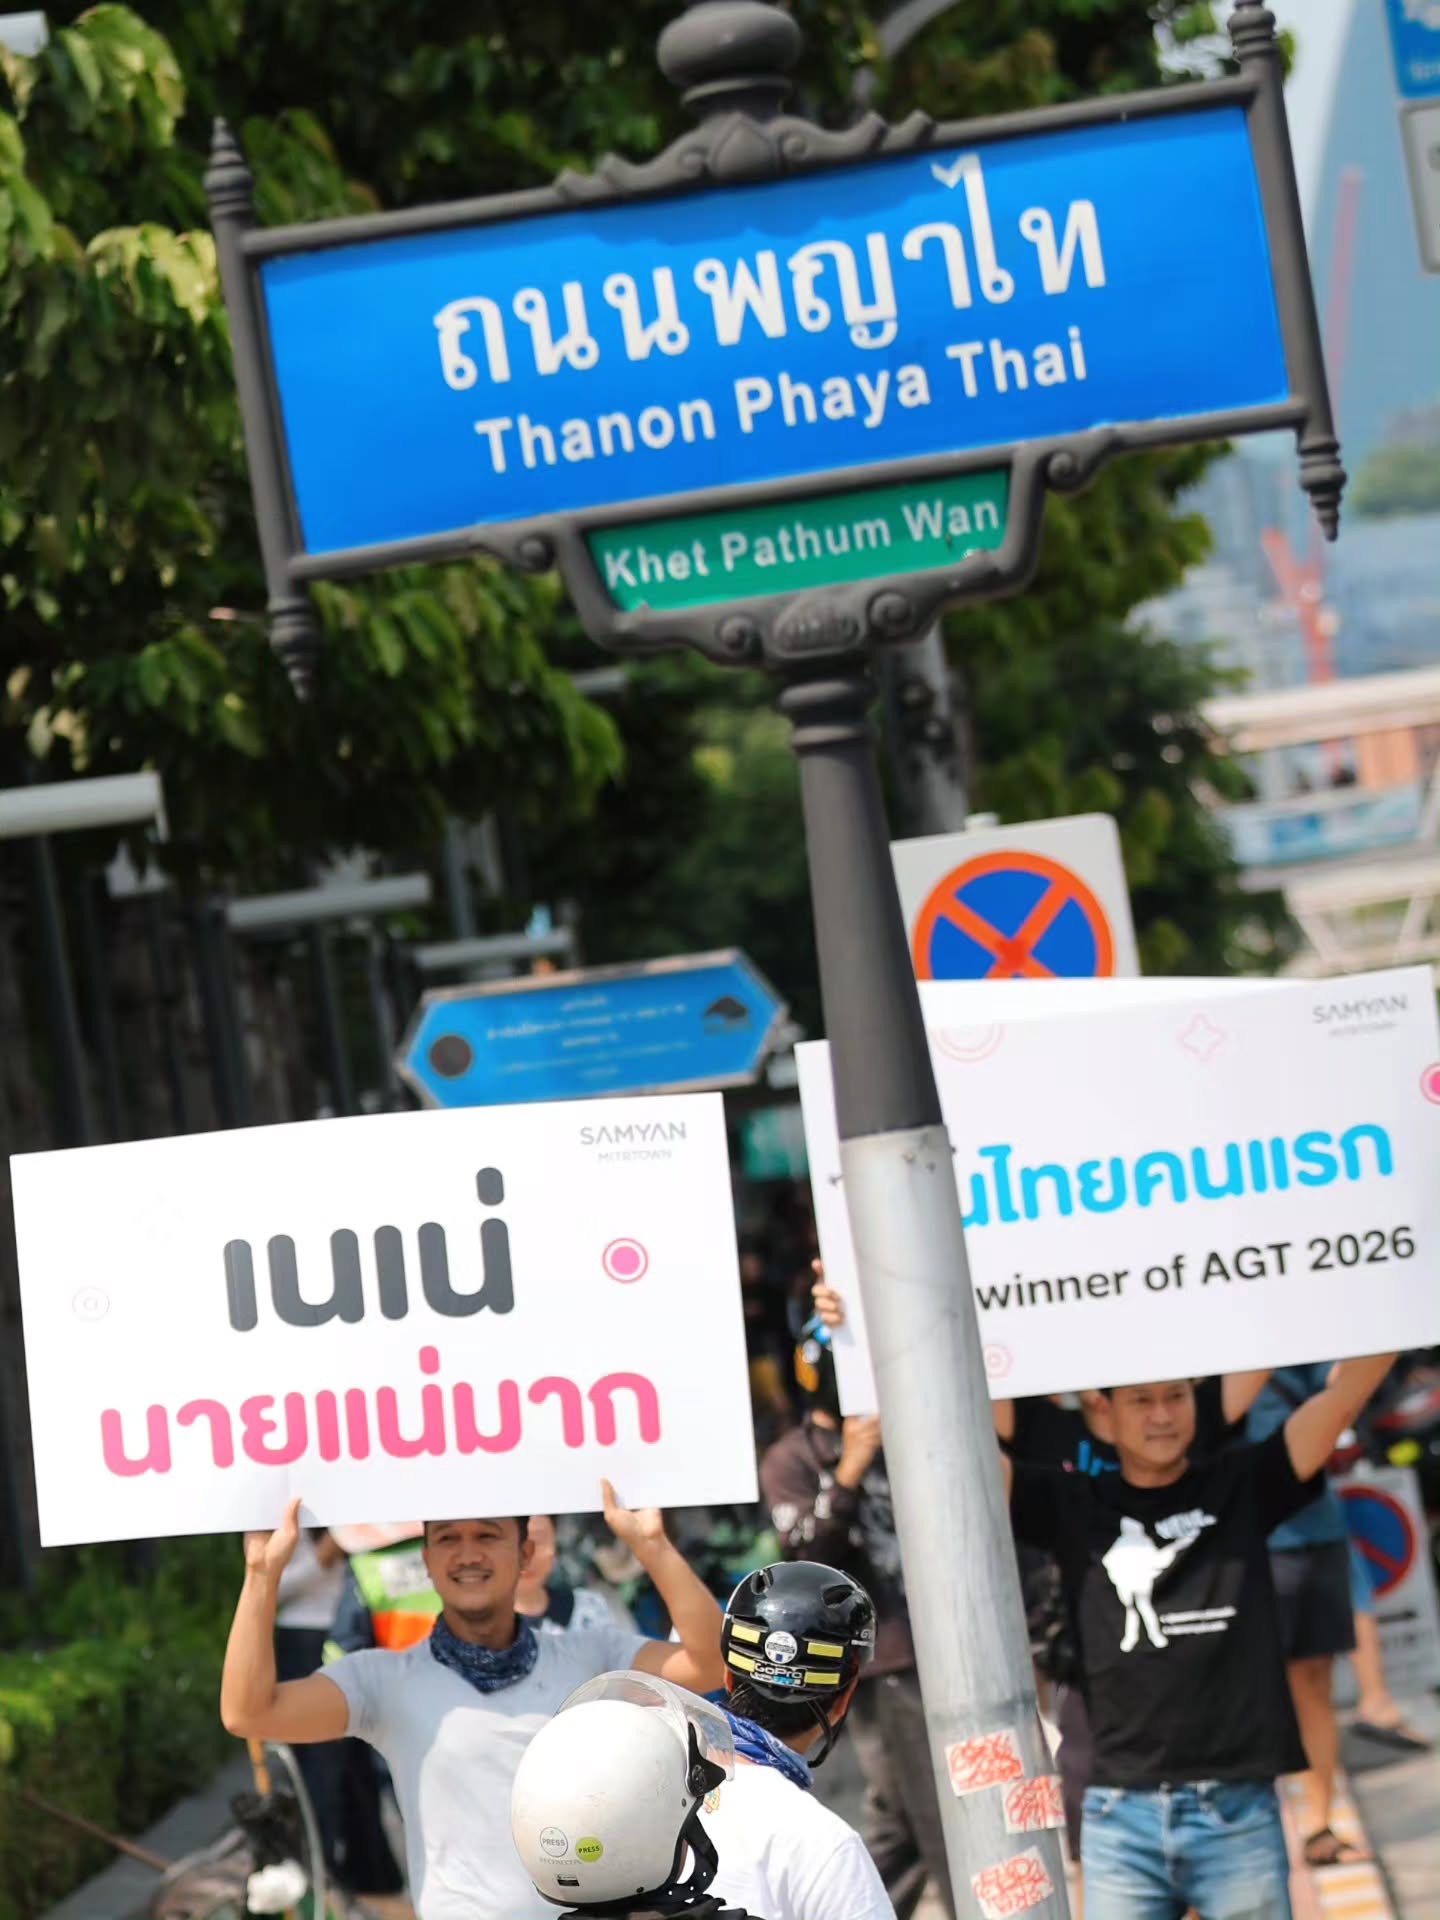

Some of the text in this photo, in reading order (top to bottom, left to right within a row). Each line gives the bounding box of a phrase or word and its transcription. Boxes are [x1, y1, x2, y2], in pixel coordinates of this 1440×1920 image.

[433, 154, 1106, 391] ถนนพญาไท
[475, 326, 1088, 473] Thanon Phaya Thai
[604, 500, 999, 589] Khet Pathum Wan
[579, 1121, 687, 1145] SAMYAN
[223, 1166, 515, 1333] เนเน่
[975, 1226, 1416, 1310] winner of AGT 2026
[101, 1345, 661, 1477] นายแน่มาก
[755, 1662, 803, 1679] GoPro
[542, 1838, 566, 1847] PRESS
[578, 1845, 600, 1854] PRESS
